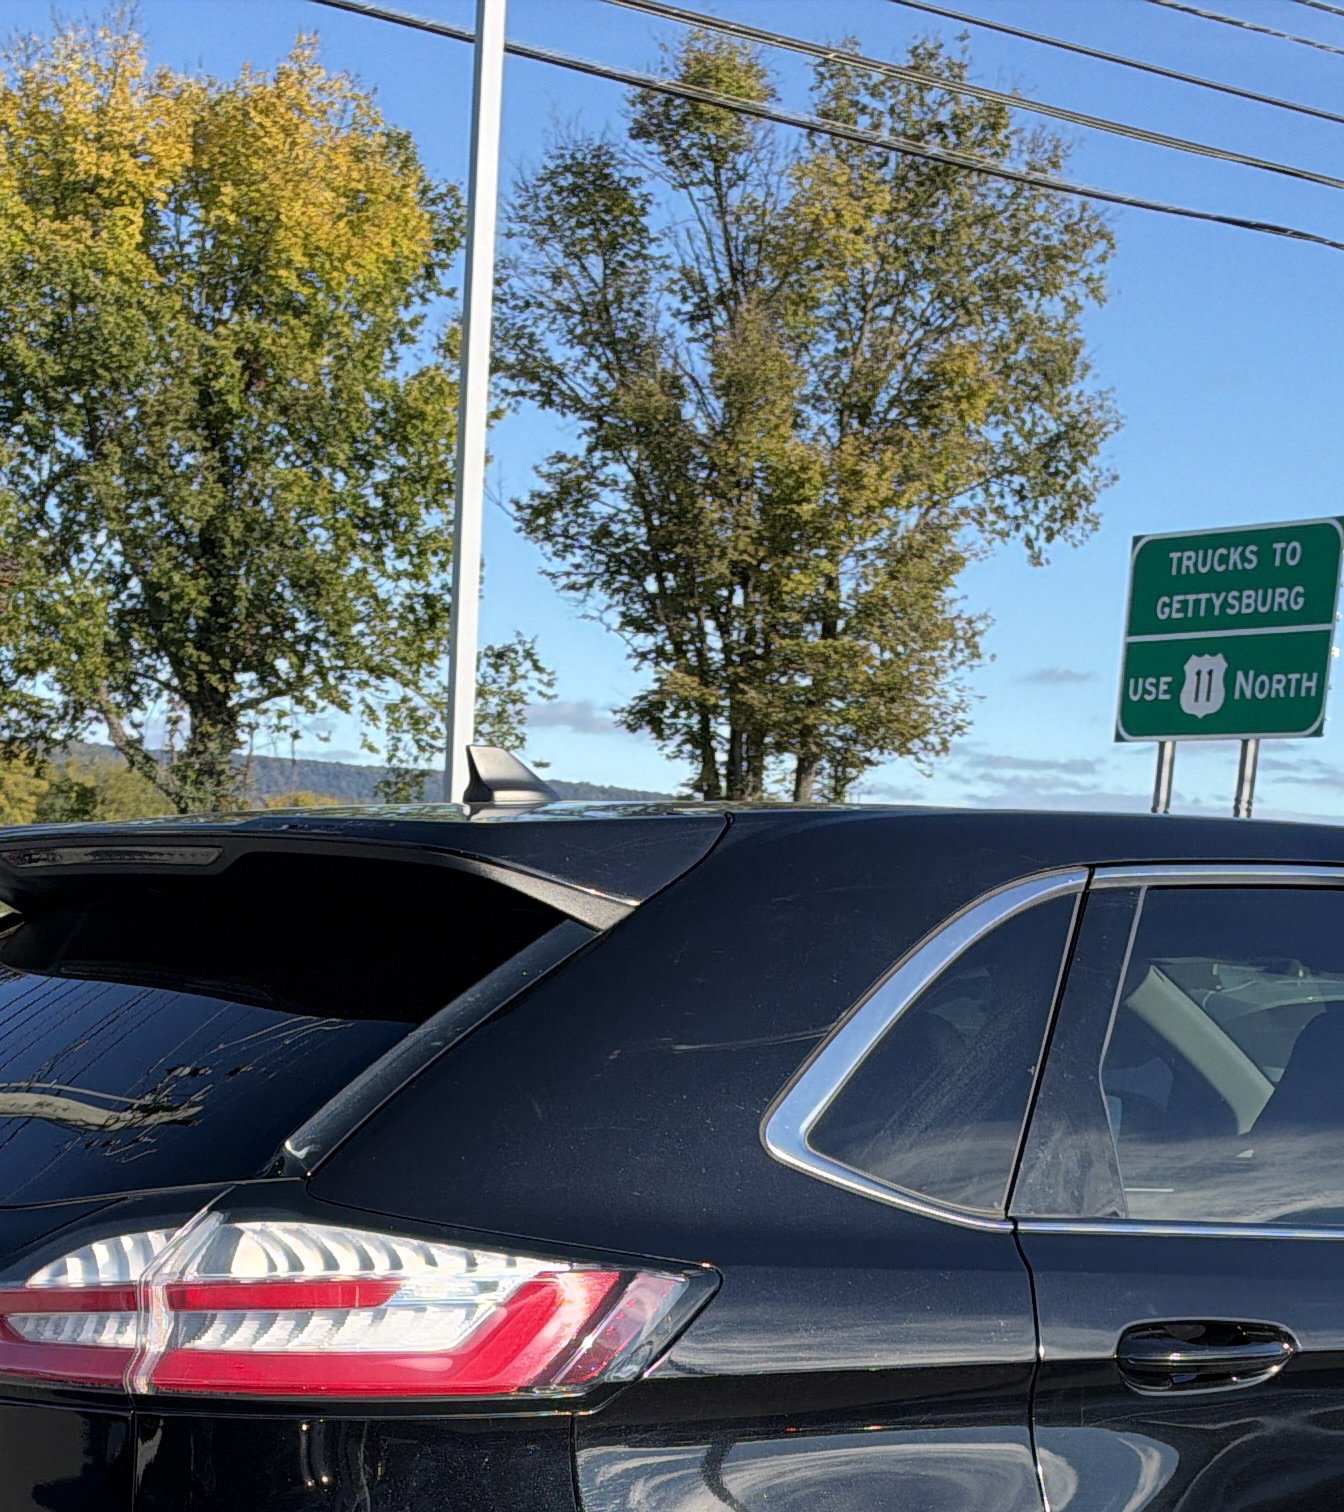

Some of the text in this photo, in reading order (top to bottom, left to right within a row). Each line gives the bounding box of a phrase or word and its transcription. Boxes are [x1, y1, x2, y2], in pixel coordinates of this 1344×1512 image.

[1168, 541, 1302, 576] TRUCKS TO
[1156, 585, 1305, 620] GETTYSBURG
[1128, 668, 1318, 703] USE 11 NORTH
